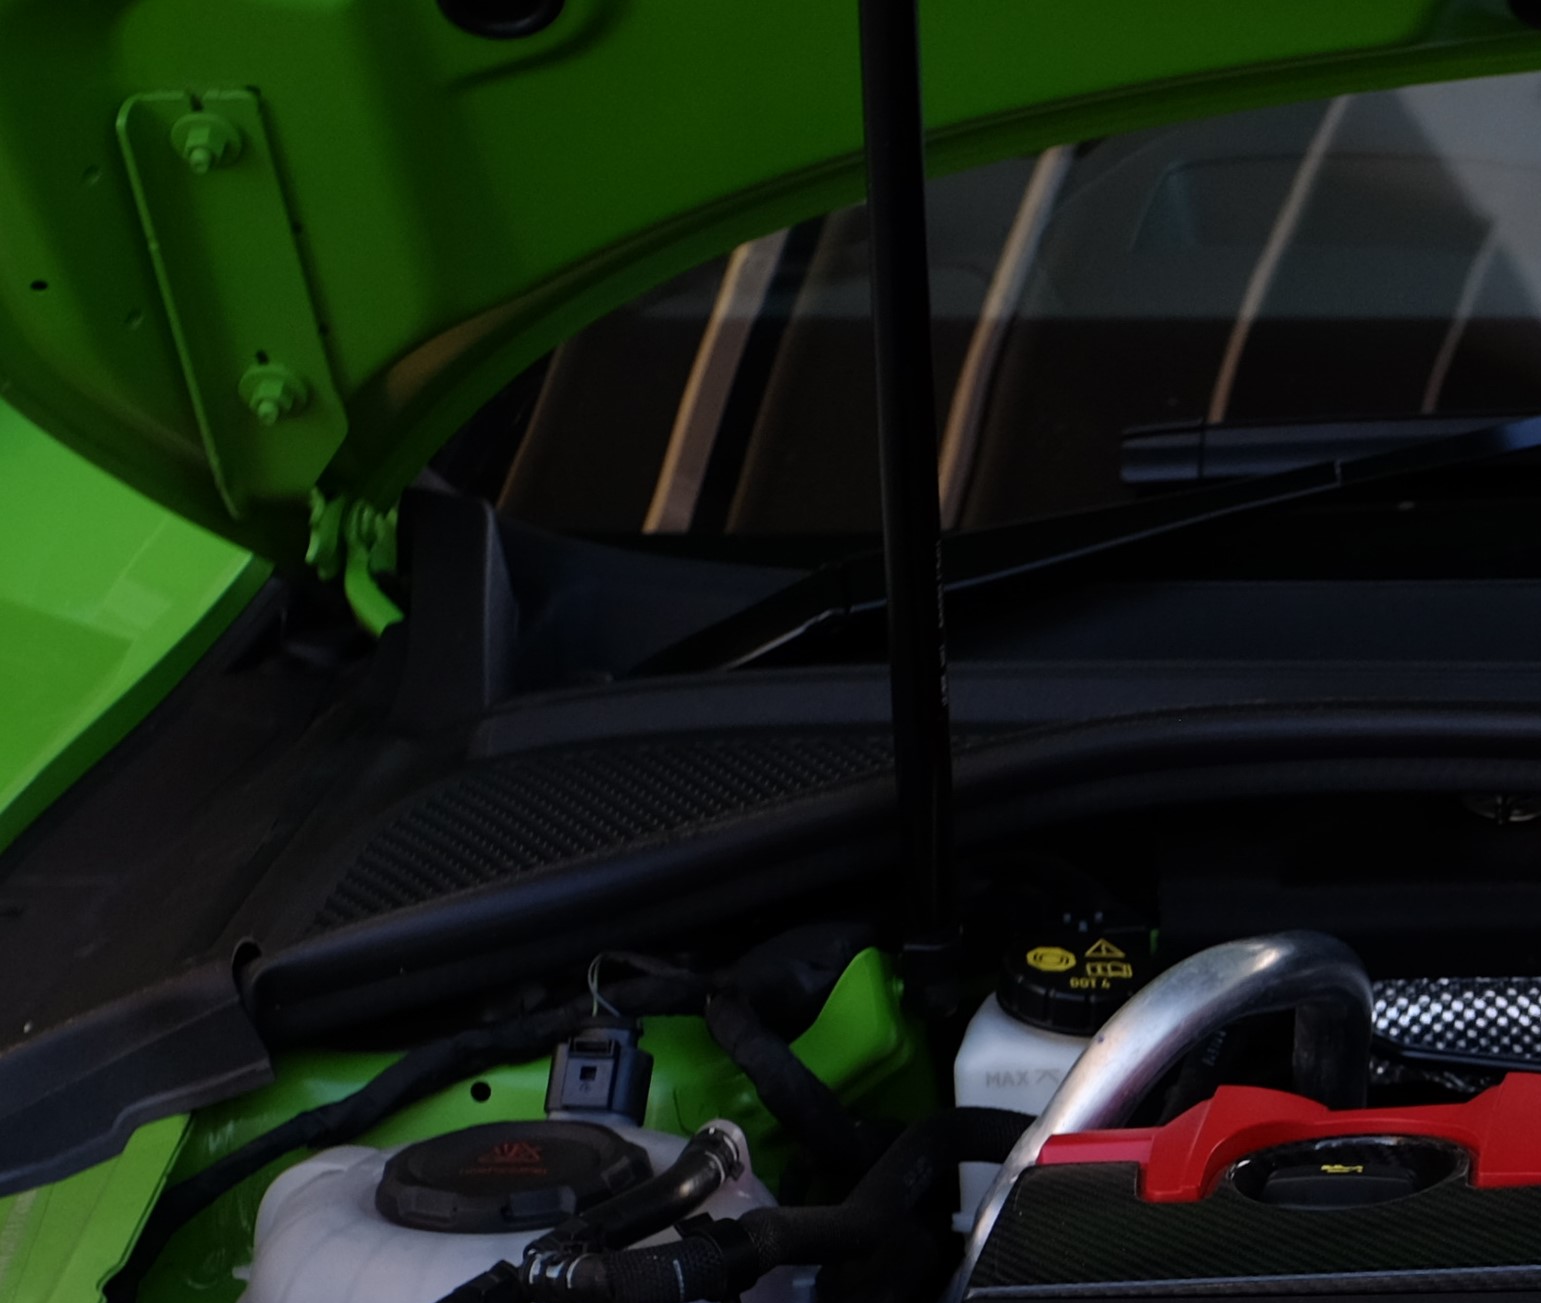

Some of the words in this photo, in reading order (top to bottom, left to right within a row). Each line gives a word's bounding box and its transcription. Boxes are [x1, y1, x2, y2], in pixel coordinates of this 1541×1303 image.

[1069, 976, 1097, 989] DOT
[1101, 978, 1112, 990] 4
[985, 1069, 1029, 1089] MAX
